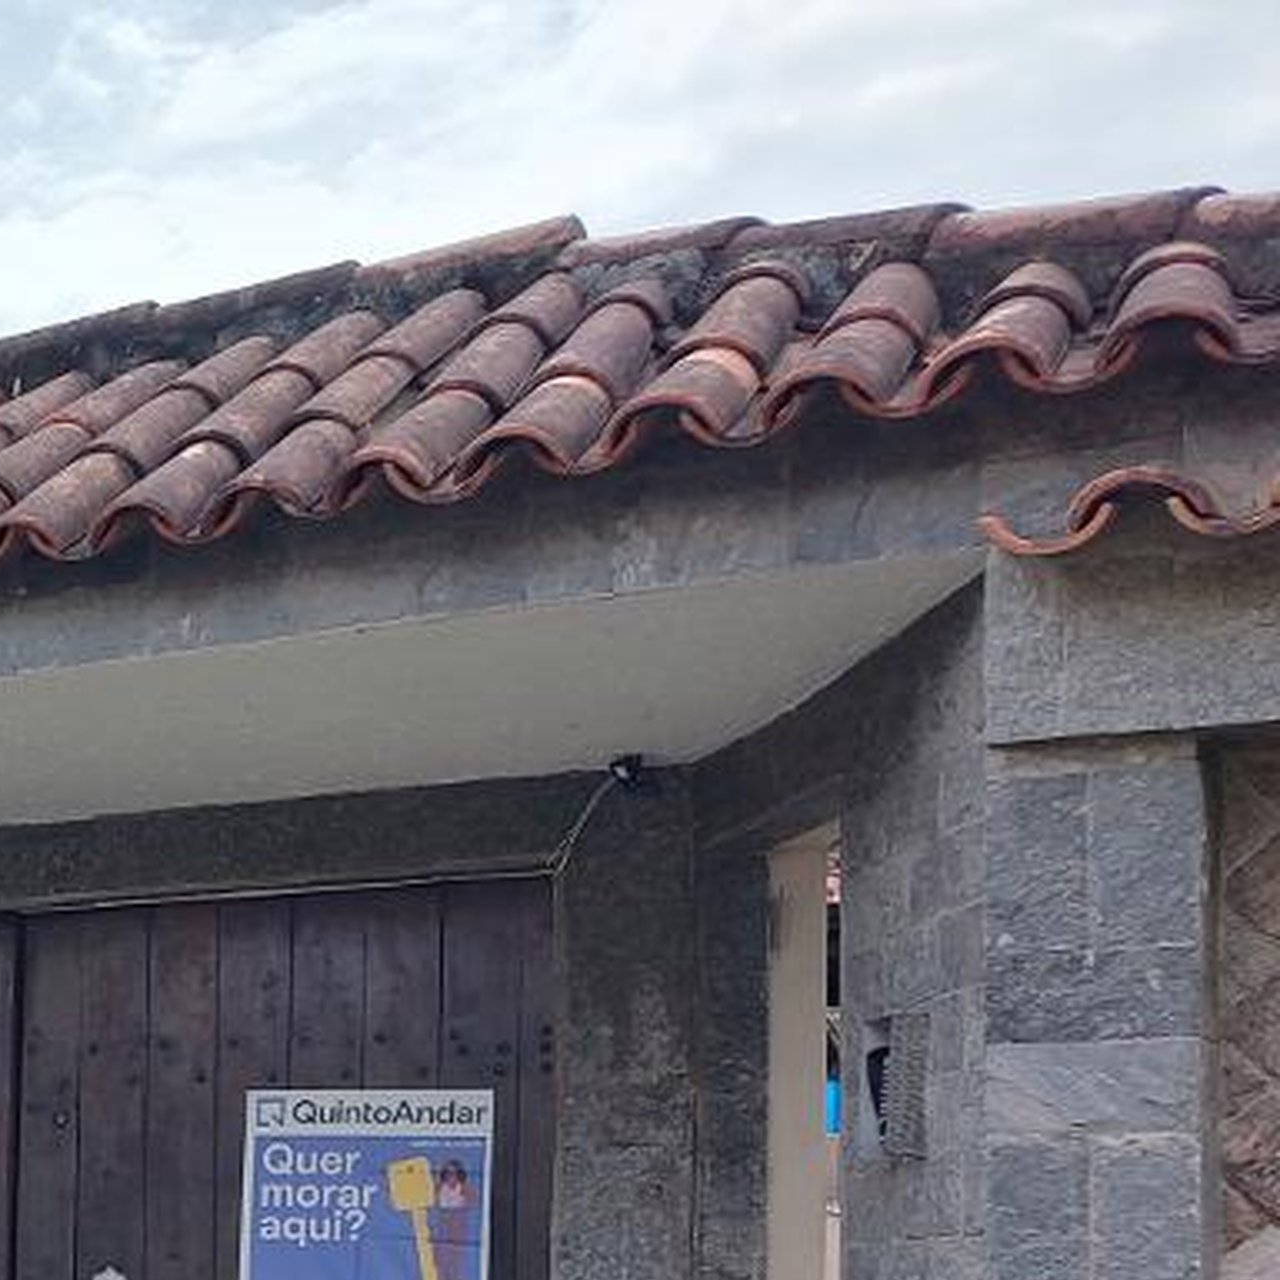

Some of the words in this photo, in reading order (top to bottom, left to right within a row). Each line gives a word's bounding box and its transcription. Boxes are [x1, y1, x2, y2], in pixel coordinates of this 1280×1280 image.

[292, 1100, 485, 1125] QuintoAndar
[262, 1143, 361, 1175] Quer
[261, 1184, 378, 1208] morar
[260, 1209, 366, 1247] aqui?
